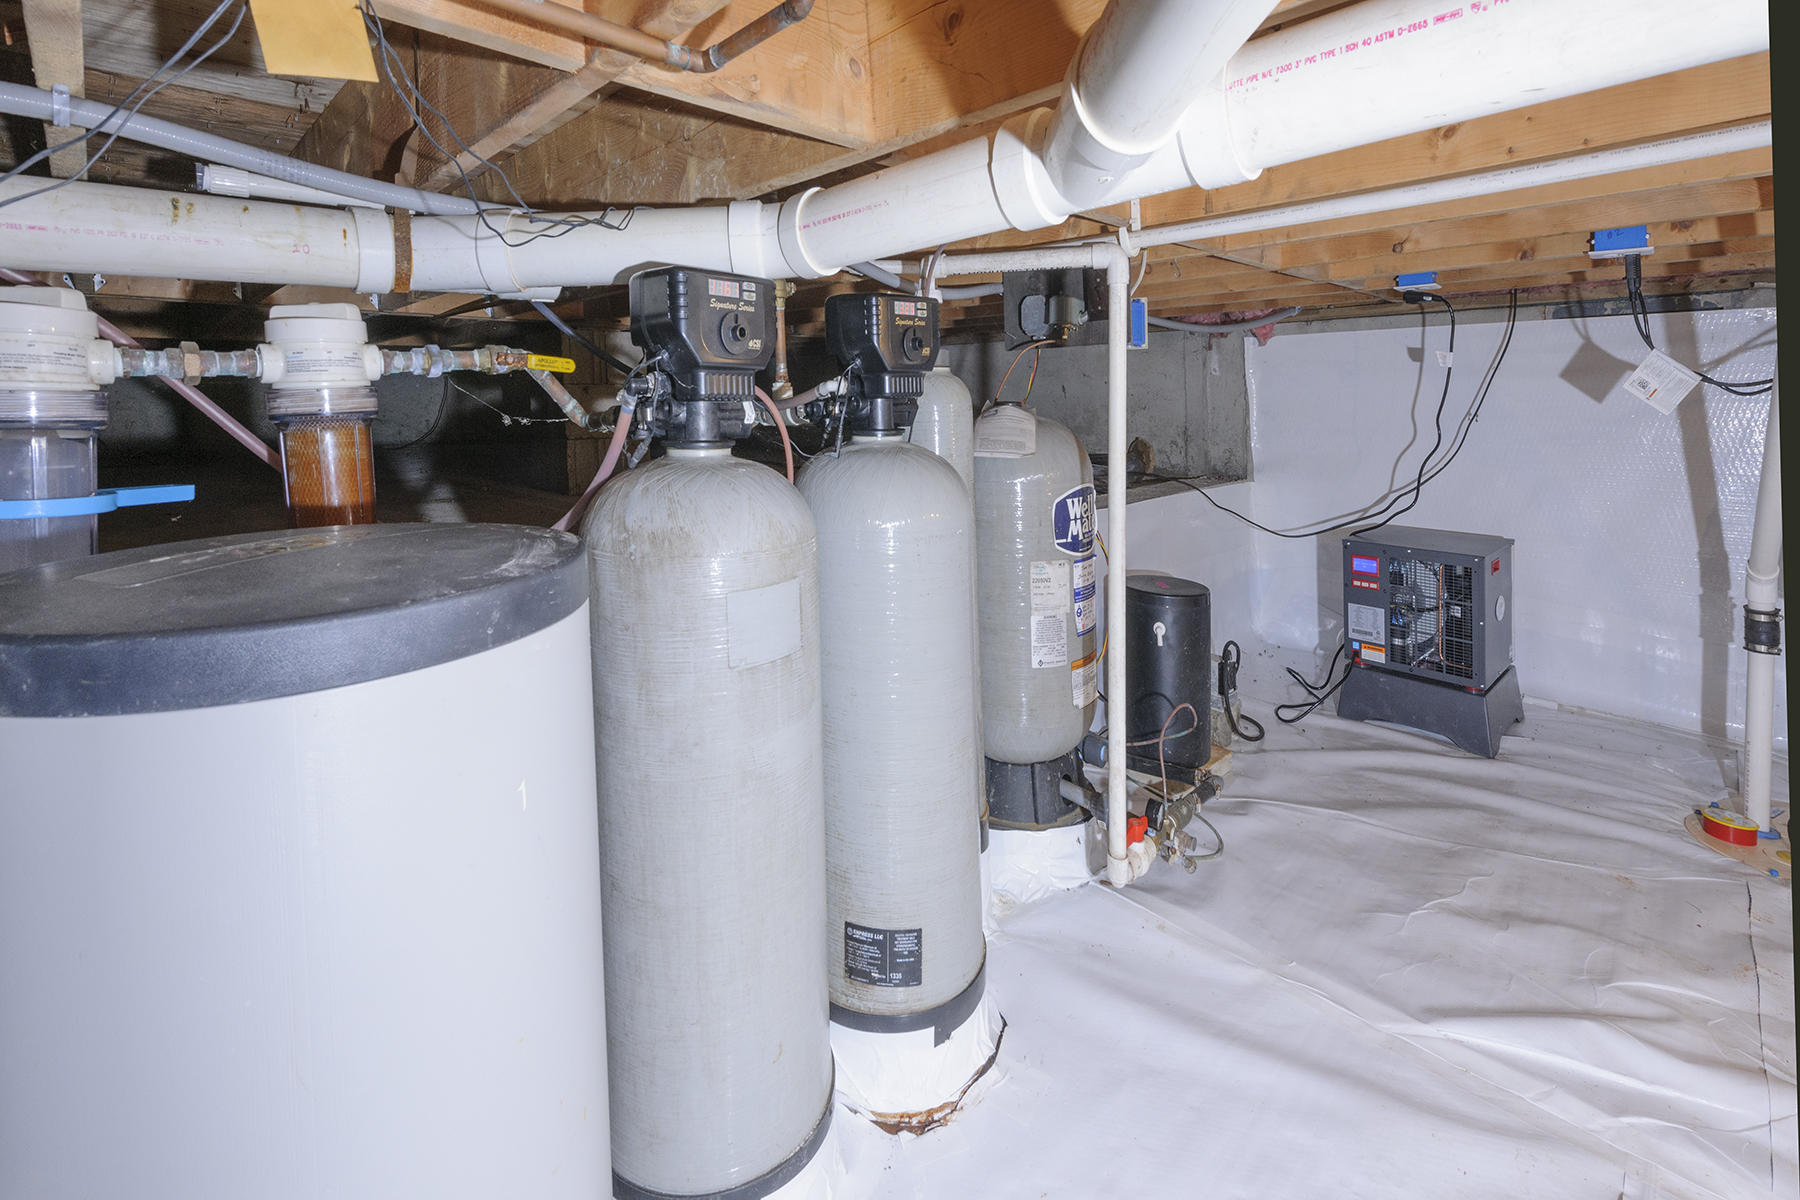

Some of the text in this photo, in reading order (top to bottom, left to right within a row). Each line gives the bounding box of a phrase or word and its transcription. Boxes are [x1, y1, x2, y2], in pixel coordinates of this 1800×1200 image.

[1304, 54, 1317, 65] PVC
[1320, 48, 1336, 60] TYPE
[1362, 37, 1372, 47] 40
[1374, 29, 1395, 43] ASTM
[709, 298, 755, 312] Signature Series
[1066, 493, 1093, 519] Well
